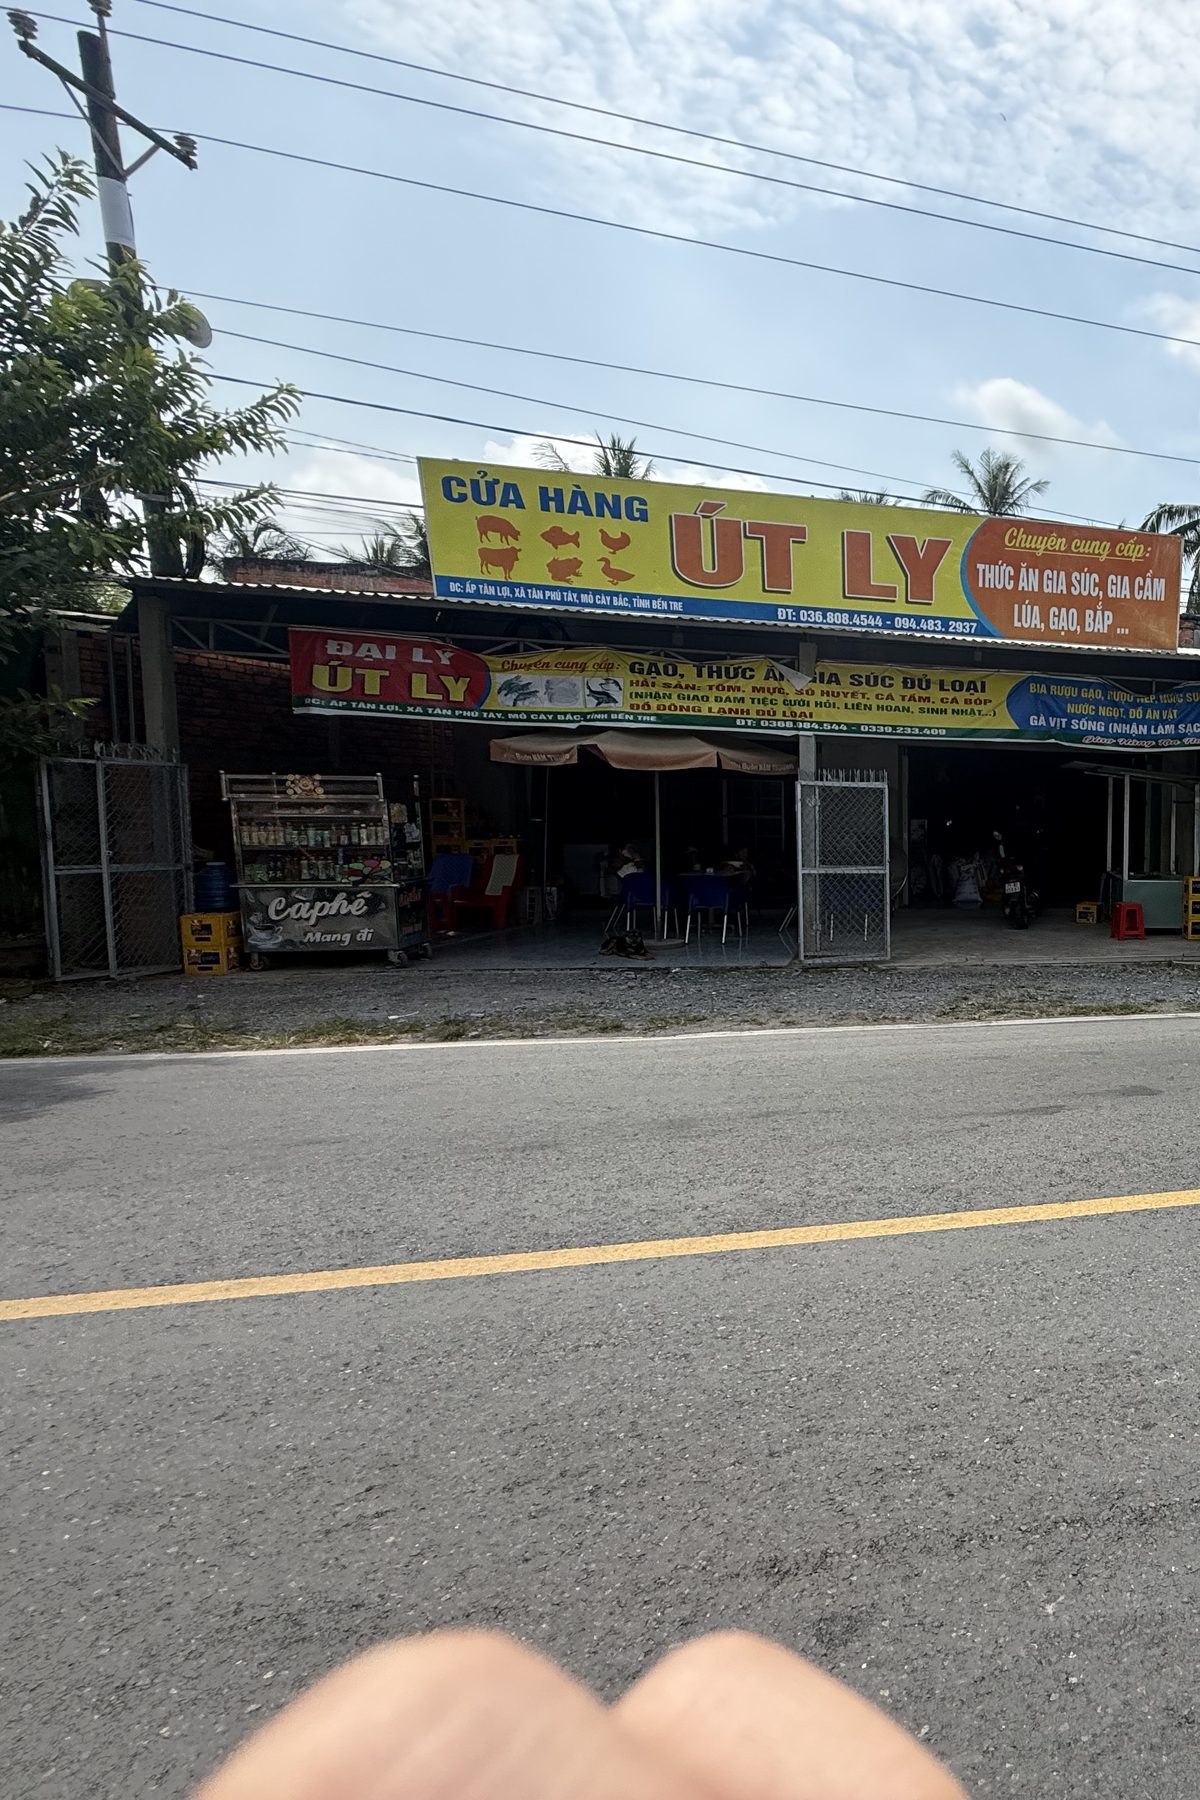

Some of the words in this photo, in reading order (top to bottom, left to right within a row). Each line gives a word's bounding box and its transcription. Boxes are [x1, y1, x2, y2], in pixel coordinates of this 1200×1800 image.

[441, 470, 526, 510] CỬA
[538, 484, 649, 522] HÀNG
[669, 500, 808, 593] ÚT
[841, 529, 953, 604] LY
[1004, 527, 1067, 556] Chuyên
[1071, 537, 1112, 561] cung
[1115, 536, 1152, 562] cấp:
[977, 560, 1014, 590] THỨC
[1018, 562, 1039, 592] ĂN
[1043, 569, 1067, 594] GIA
[1071, 567, 1104, 600] SÚC,
[1107, 574, 1131, 599] GIA
[1134, 569, 1166, 601] CẦM
[449, 582, 464, 593] ĐC:
[465, 580, 477, 594] ẤP
[478, 583, 496, 596] TÂN
[497, 586, 513, 599] LỢI,
[527, 587, 544, 600] TÂN
[545, 589, 561, 601] PHÚ
[562, 589, 579, 603] TÂY,
[595, 591, 612, 605] CÀY
[613, 592, 631, 608] BẮC,
[652, 595, 668, 610] BẾN
[669, 600, 684, 612] TRE
[777, 607, 797, 620] ĐT:
[799, 609, 883, 627] 036.808.4544
[948, 621, 977, 634] 2937
[1013, 599, 1045, 632] LÚA,
[1049, 606, 1081, 636] GẠO,
[1085, 601, 1113, 633] BẮP
[325, 639, 397, 662] ĐẠI
[554, 661, 588, 673] cung
[629, 661, 685, 679] GẠO,
[692, 662, 755, 680] THỨC
[849, 671, 894, 688] SÚC
[902, 673, 931, 691] ĐỦ
[939, 678, 987, 696] LOẠI
[312, 660, 390, 695] ÚT
[411, 672, 471, 702] LY
[1029, 683, 1047, 694] BIA
[629, 691, 673, 701] (NHẬN
[677, 692, 710, 703] GIAO
[714, 694, 745, 704] ĐÁM
[749, 696, 779, 707] TIỆC
[844, 702, 873, 711] LIÊN
[918, 706, 948, 715] SINH
[875, 691, 895, 701] CÁ
[940, 696, 961, 705] CÁ
[629, 702, 652, 712] ĐỒ
[656, 703, 702, 713] ĐÔNG
[707, 706, 751, 716] LẠNH
[755, 707, 777, 717] ĐỦ
[782, 710, 813, 719] LOẠI
[735, 718, 757, 727] ĐT:
[1066, 702, 1096, 715] NƯỚC
[1129, 705, 1143, 719] ĐỒ
[1029, 713, 1047, 727] GÀ
[1049, 716, 1068, 730] VỊT
[1071, 716, 1105, 732] SỐNG
[1108, 721, 1148, 737] (NHẬN
[1150, 721, 1175, 735] LÀM
[304, 931, 352, 946] Mang
[356, 928, 374, 942] đi
